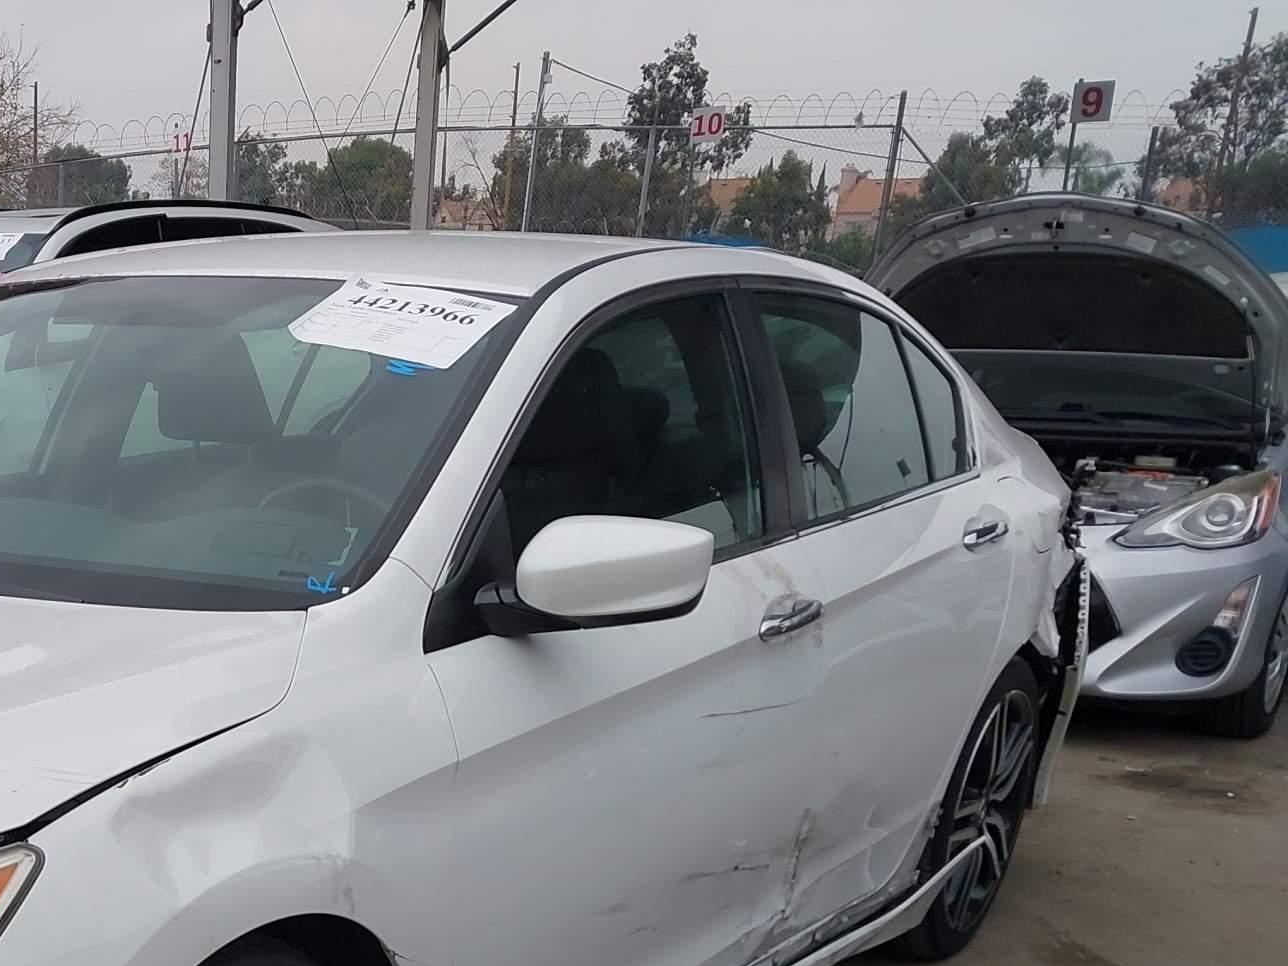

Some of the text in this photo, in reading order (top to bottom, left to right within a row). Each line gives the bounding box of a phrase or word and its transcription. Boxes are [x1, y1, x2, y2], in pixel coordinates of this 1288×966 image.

[1081, 86, 1104, 118] 9
[693, 112, 723, 137] 10
[173, 132, 191, 153] 11
[347, 294, 481, 326] 44213966
